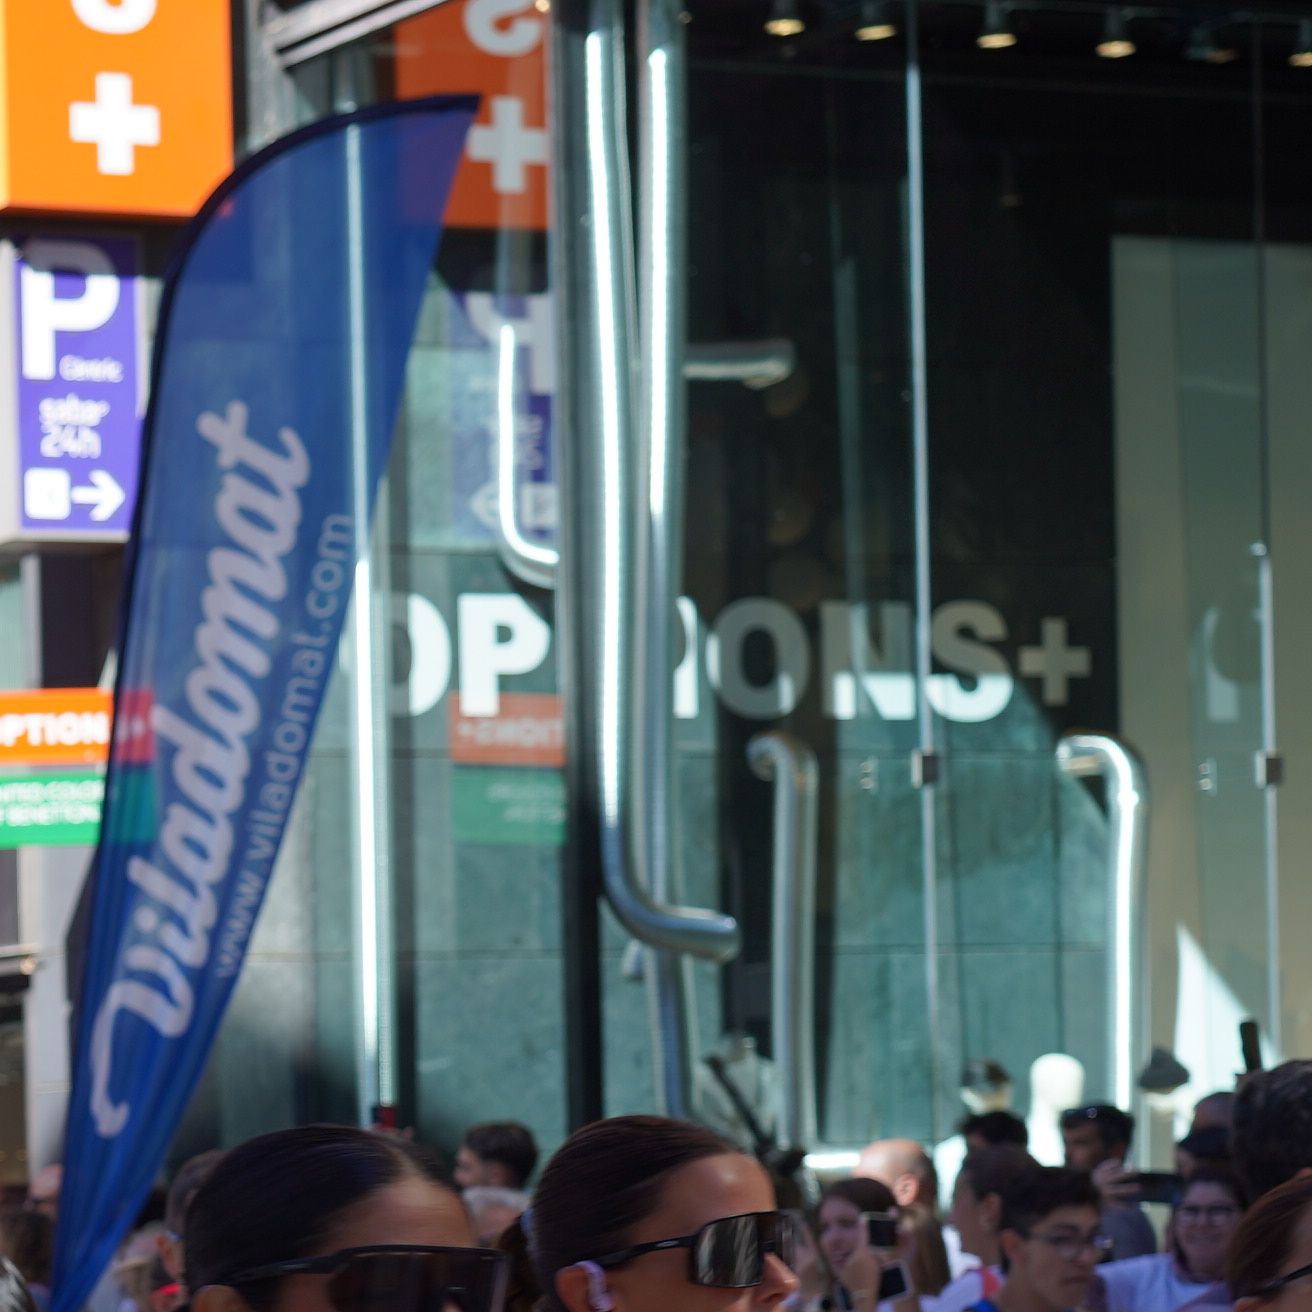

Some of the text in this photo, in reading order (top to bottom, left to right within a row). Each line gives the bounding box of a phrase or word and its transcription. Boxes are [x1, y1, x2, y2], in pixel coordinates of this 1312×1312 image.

[21, 241, 120, 380] P
[338, 592, 1092, 723] OPIONS+
[214, 511, 355, 982] www.viladomat.com
